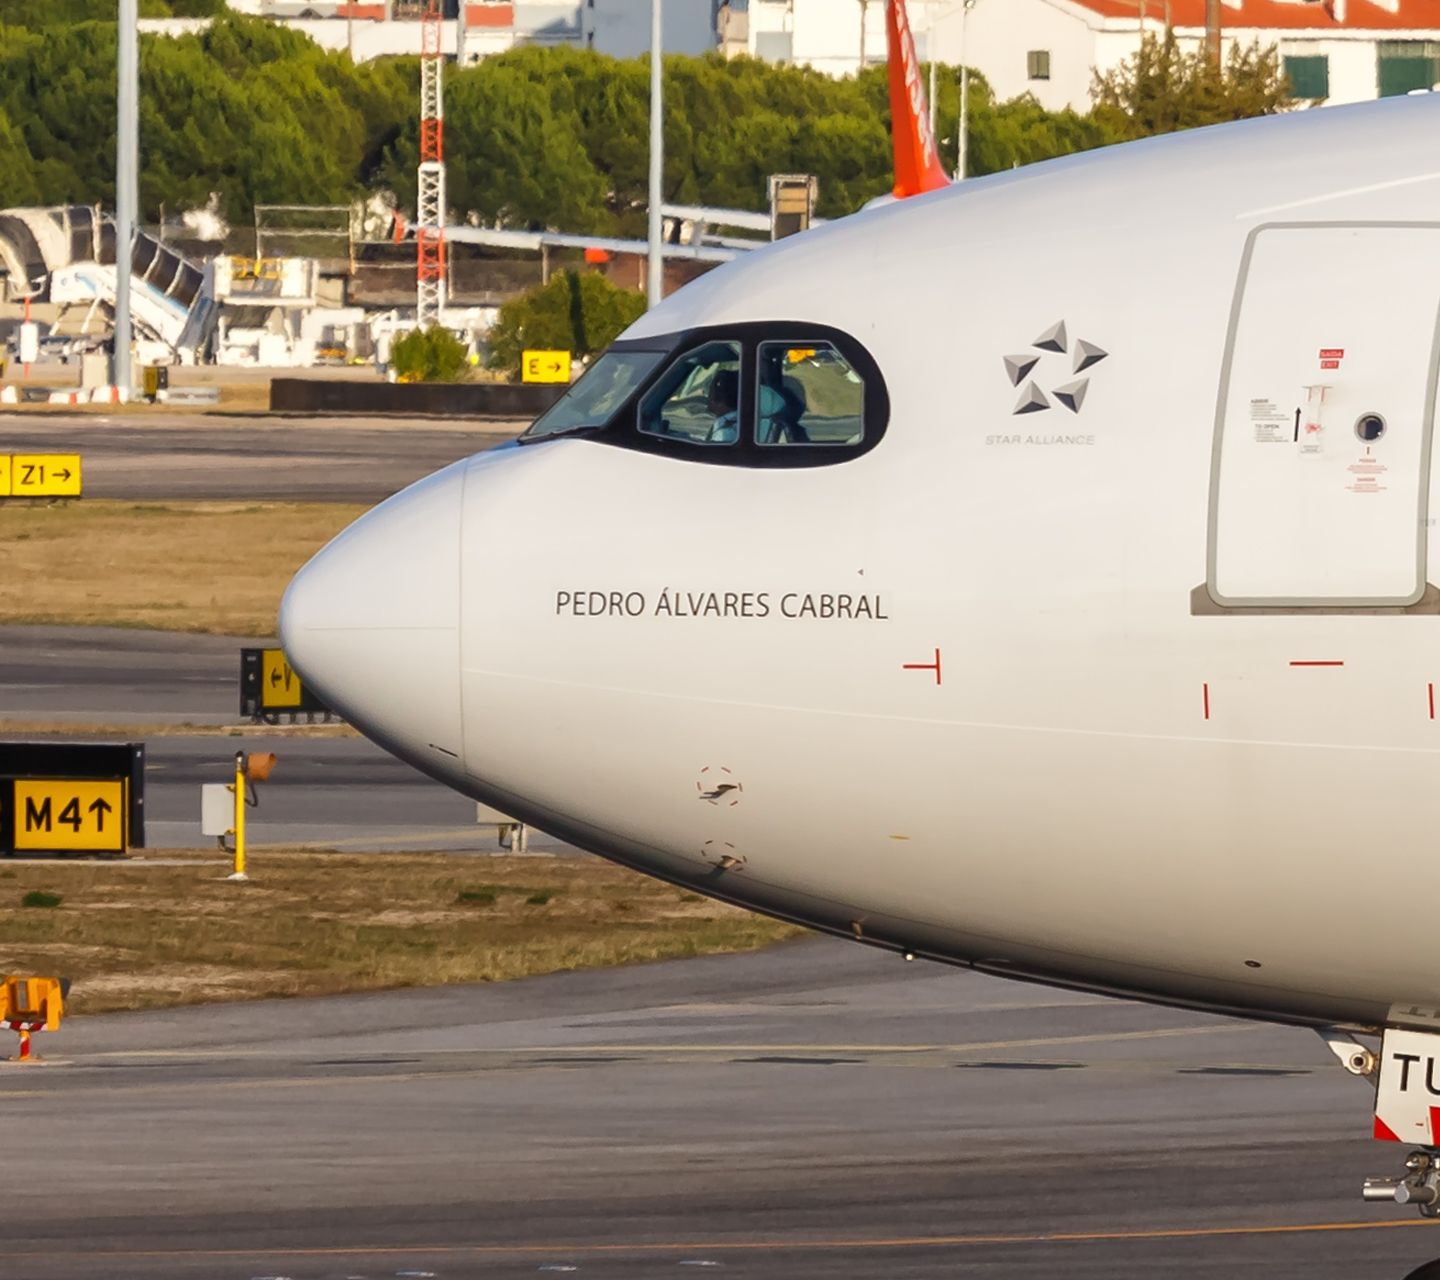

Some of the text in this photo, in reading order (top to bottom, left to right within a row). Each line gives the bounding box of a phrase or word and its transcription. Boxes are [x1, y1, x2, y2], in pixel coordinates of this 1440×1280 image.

[529, 358, 539, 375] E
[986, 435, 1095, 446] STAR ALLIANCE
[21, 465, 44, 485] Z1
[556, 587, 888, 620] PEDRO ÁLVARES CABRAL
[25, 796, 82, 832] M4
